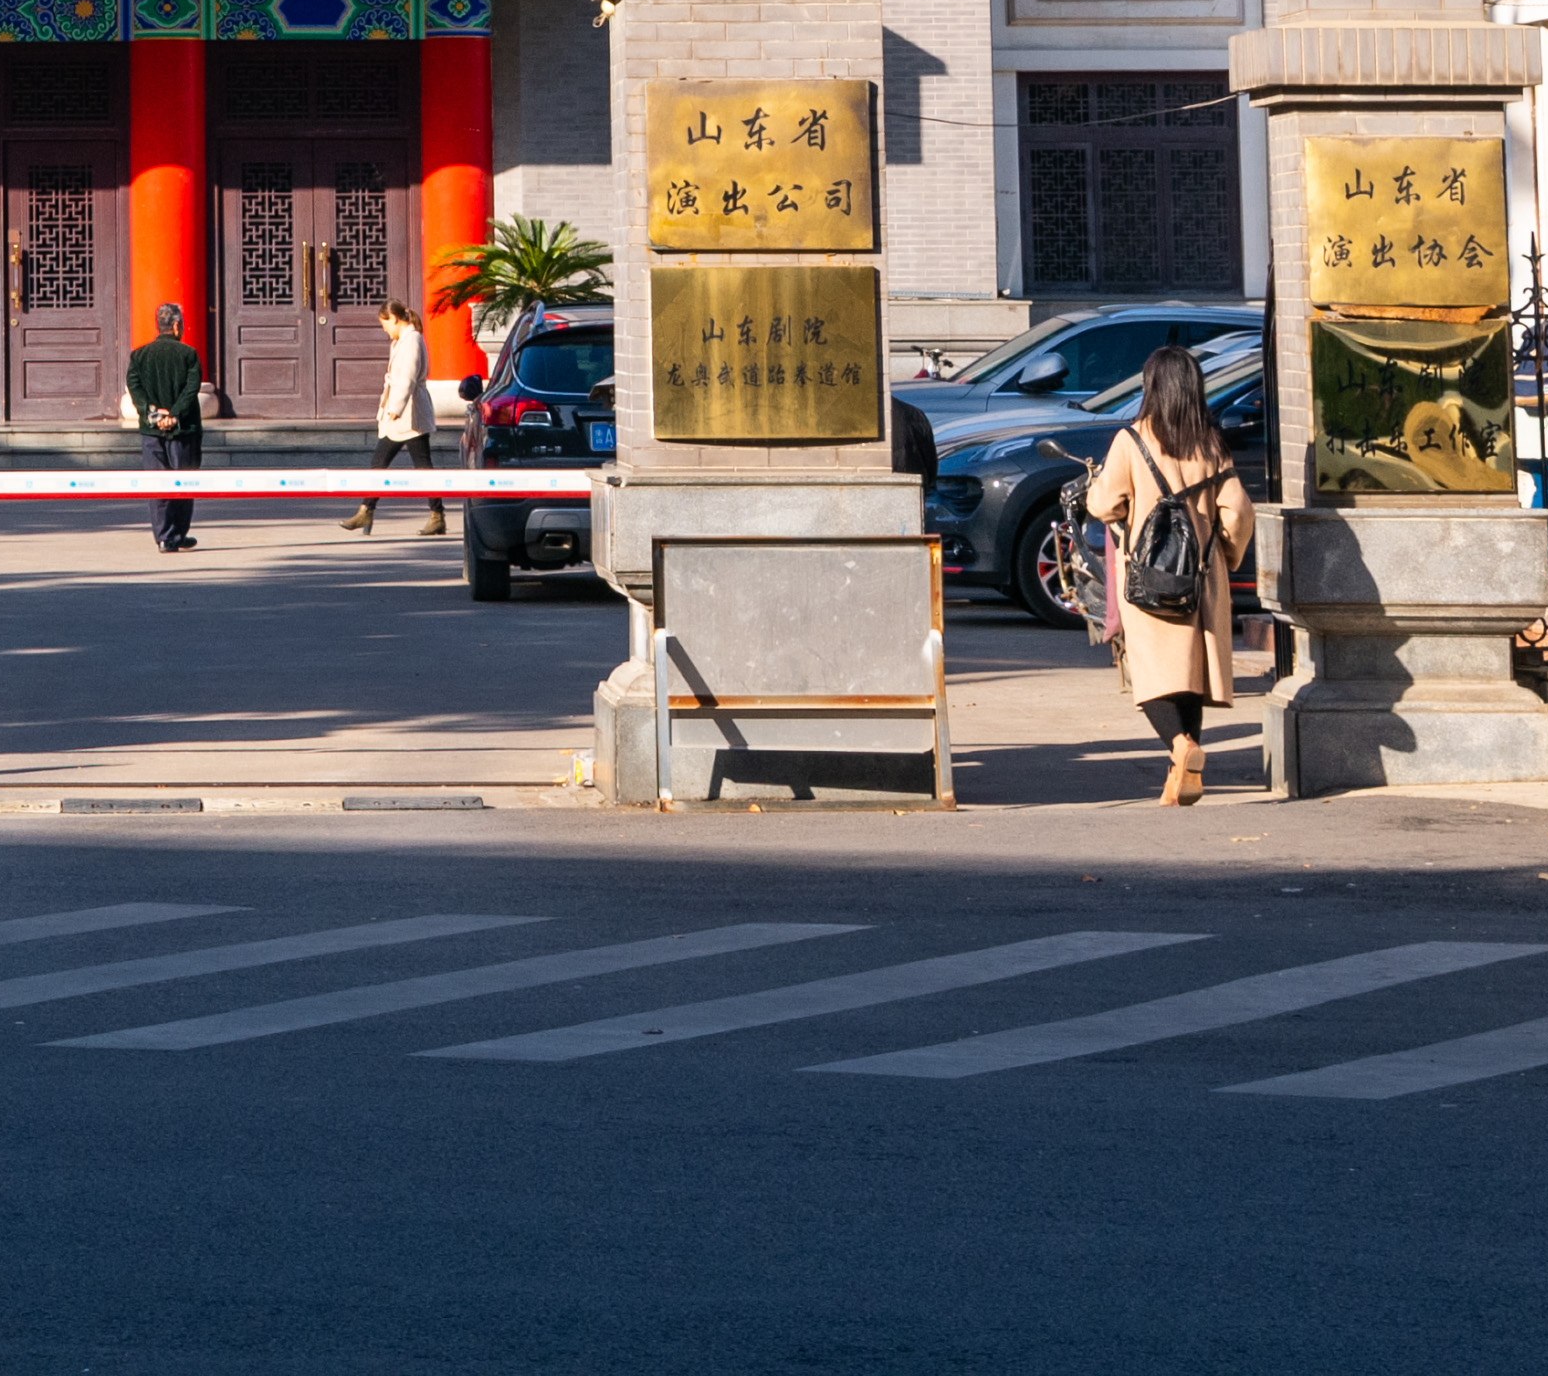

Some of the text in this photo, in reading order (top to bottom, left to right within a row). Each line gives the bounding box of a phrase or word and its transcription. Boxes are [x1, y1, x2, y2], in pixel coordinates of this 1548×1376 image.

[686, 106, 830, 152] 山东省
[666, 178, 854, 217] 演出公司
[1345, 164, 1467, 206] 山东省
[1322, 232, 1495, 270] 演出协会
[701, 314, 829, 347] 山东剧院
[666, 360, 863, 389] 龙奥武道跆拳道馆
[1337, 357, 1490, 398] 山东剧院
[1325, 418, 1504, 459] 打击乐工作室
